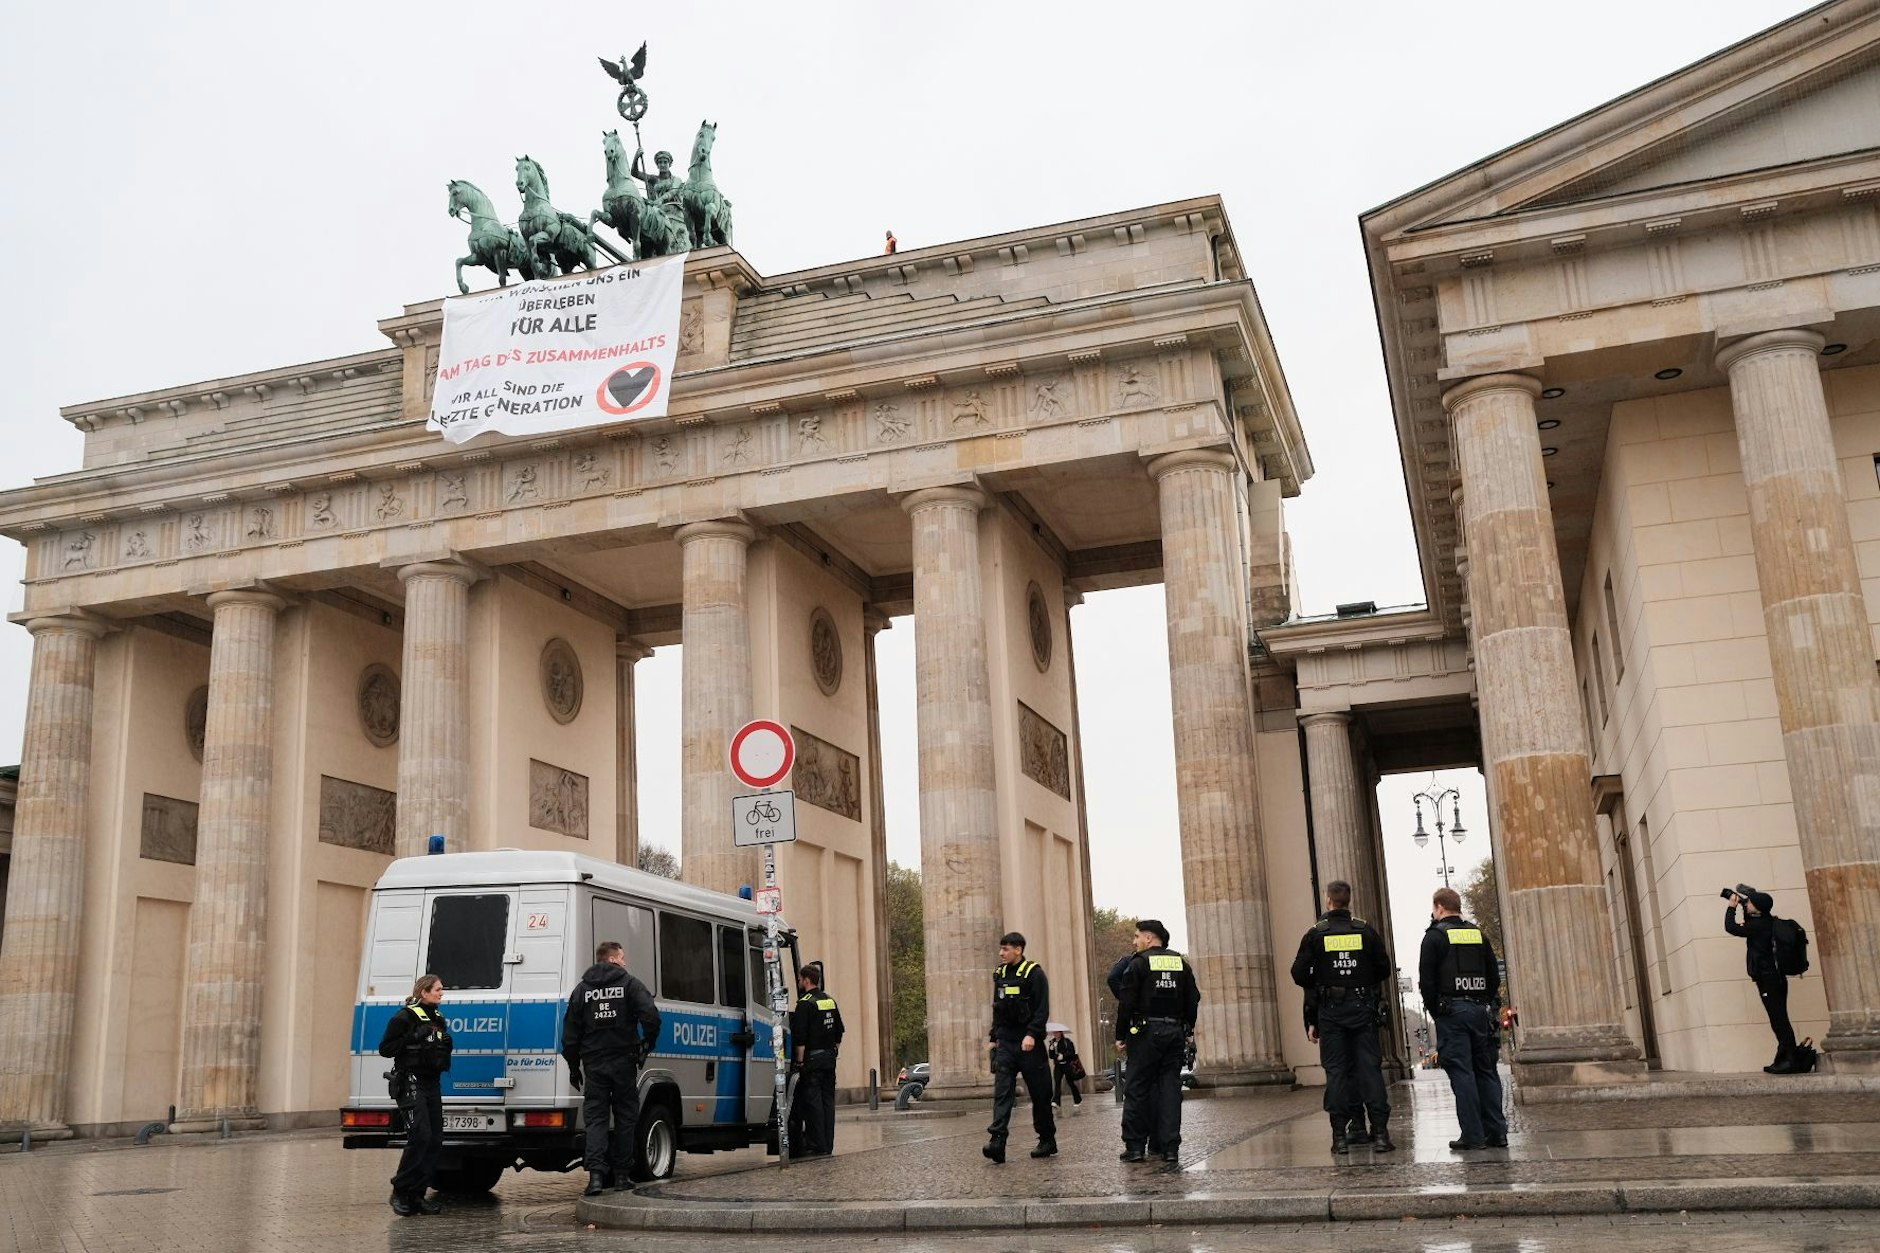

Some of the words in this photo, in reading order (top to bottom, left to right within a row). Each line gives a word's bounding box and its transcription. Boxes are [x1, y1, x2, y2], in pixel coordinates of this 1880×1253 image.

[619, 268, 641, 281] EIN
[549, 314, 598, 333] ALLE
[440, 364, 460, 380] AM
[464, 354, 491, 372] TAG
[496, 349, 522, 367] DS
[526, 334, 666, 365] ZUSAMMENHALTS
[503, 380, 537, 396] SIND
[541, 383, 565, 395] DIE
[431, 406, 480, 429] LEZTE
[484, 395, 584, 418] GNERATION
[755, 826, 775, 839] frei
[528, 914, 547, 929] 24
[1326, 937, 1361, 949] POLIZEI
[1339, 951, 1350, 960] BE
[1333, 959, 1357, 968] 14130
[1161, 971, 1171, 980] BE
[584, 986, 625, 1003] POLIZEI
[599, 1002, 610, 1011] BE
[594, 1010, 617, 1019] 24223
[673, 1021, 717, 1047] POLIZEI
[507, 1058, 518, 1066] Da
[521, 1057, 533, 1067] für
[535, 1057, 555, 1067] Dich
[454, 1117, 479, 1128] 7398
